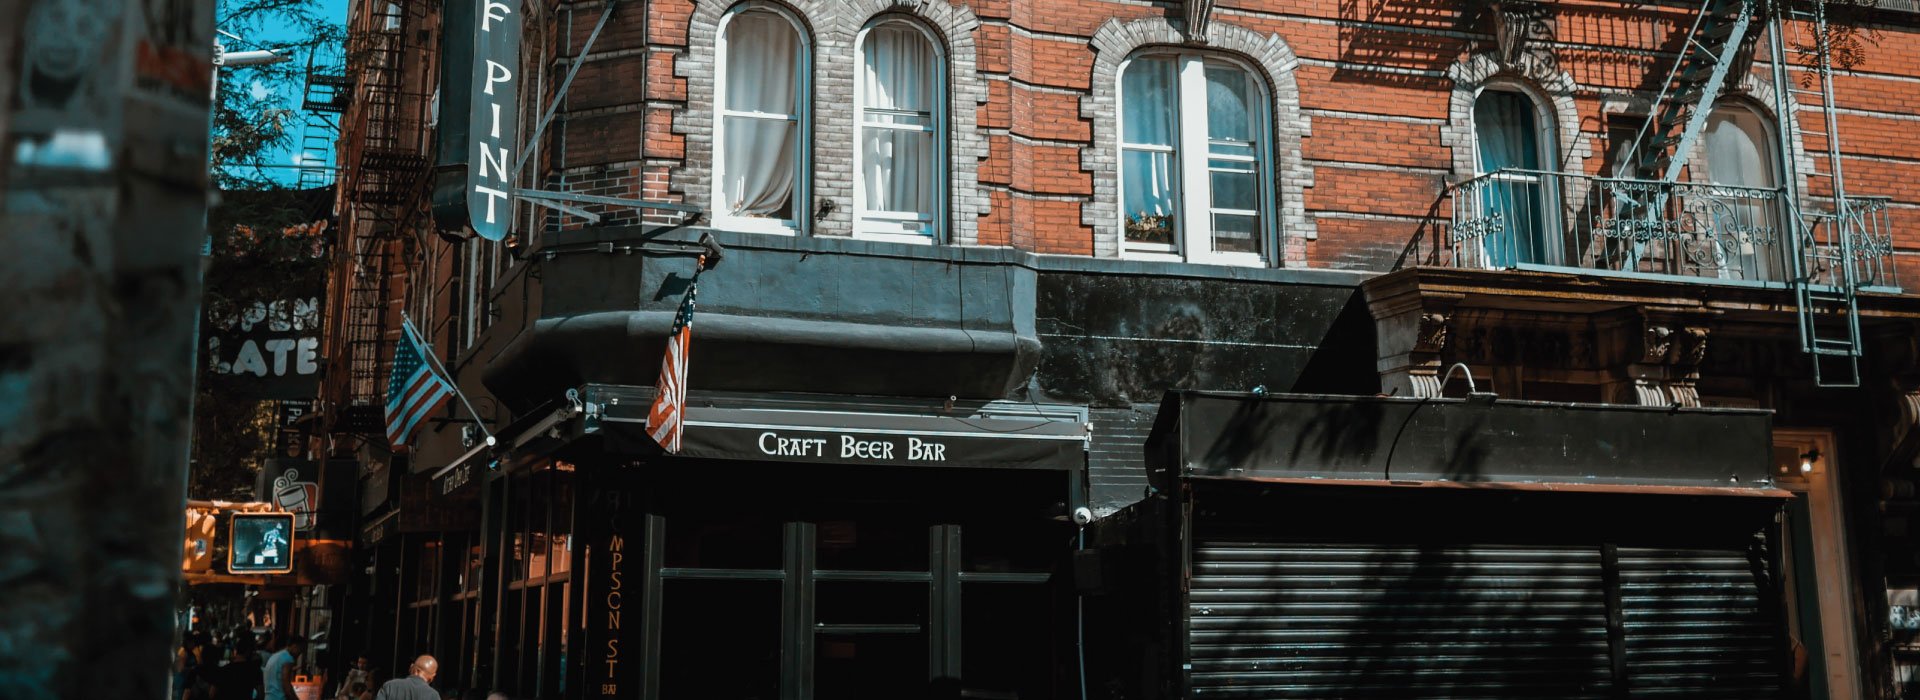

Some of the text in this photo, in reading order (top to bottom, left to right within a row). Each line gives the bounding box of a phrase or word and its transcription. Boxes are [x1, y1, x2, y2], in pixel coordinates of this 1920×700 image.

[475, 58, 512, 224] PINT
[208, 336, 319, 378] LATE
[758, 432, 946, 461] CRAFT BEER BAR
